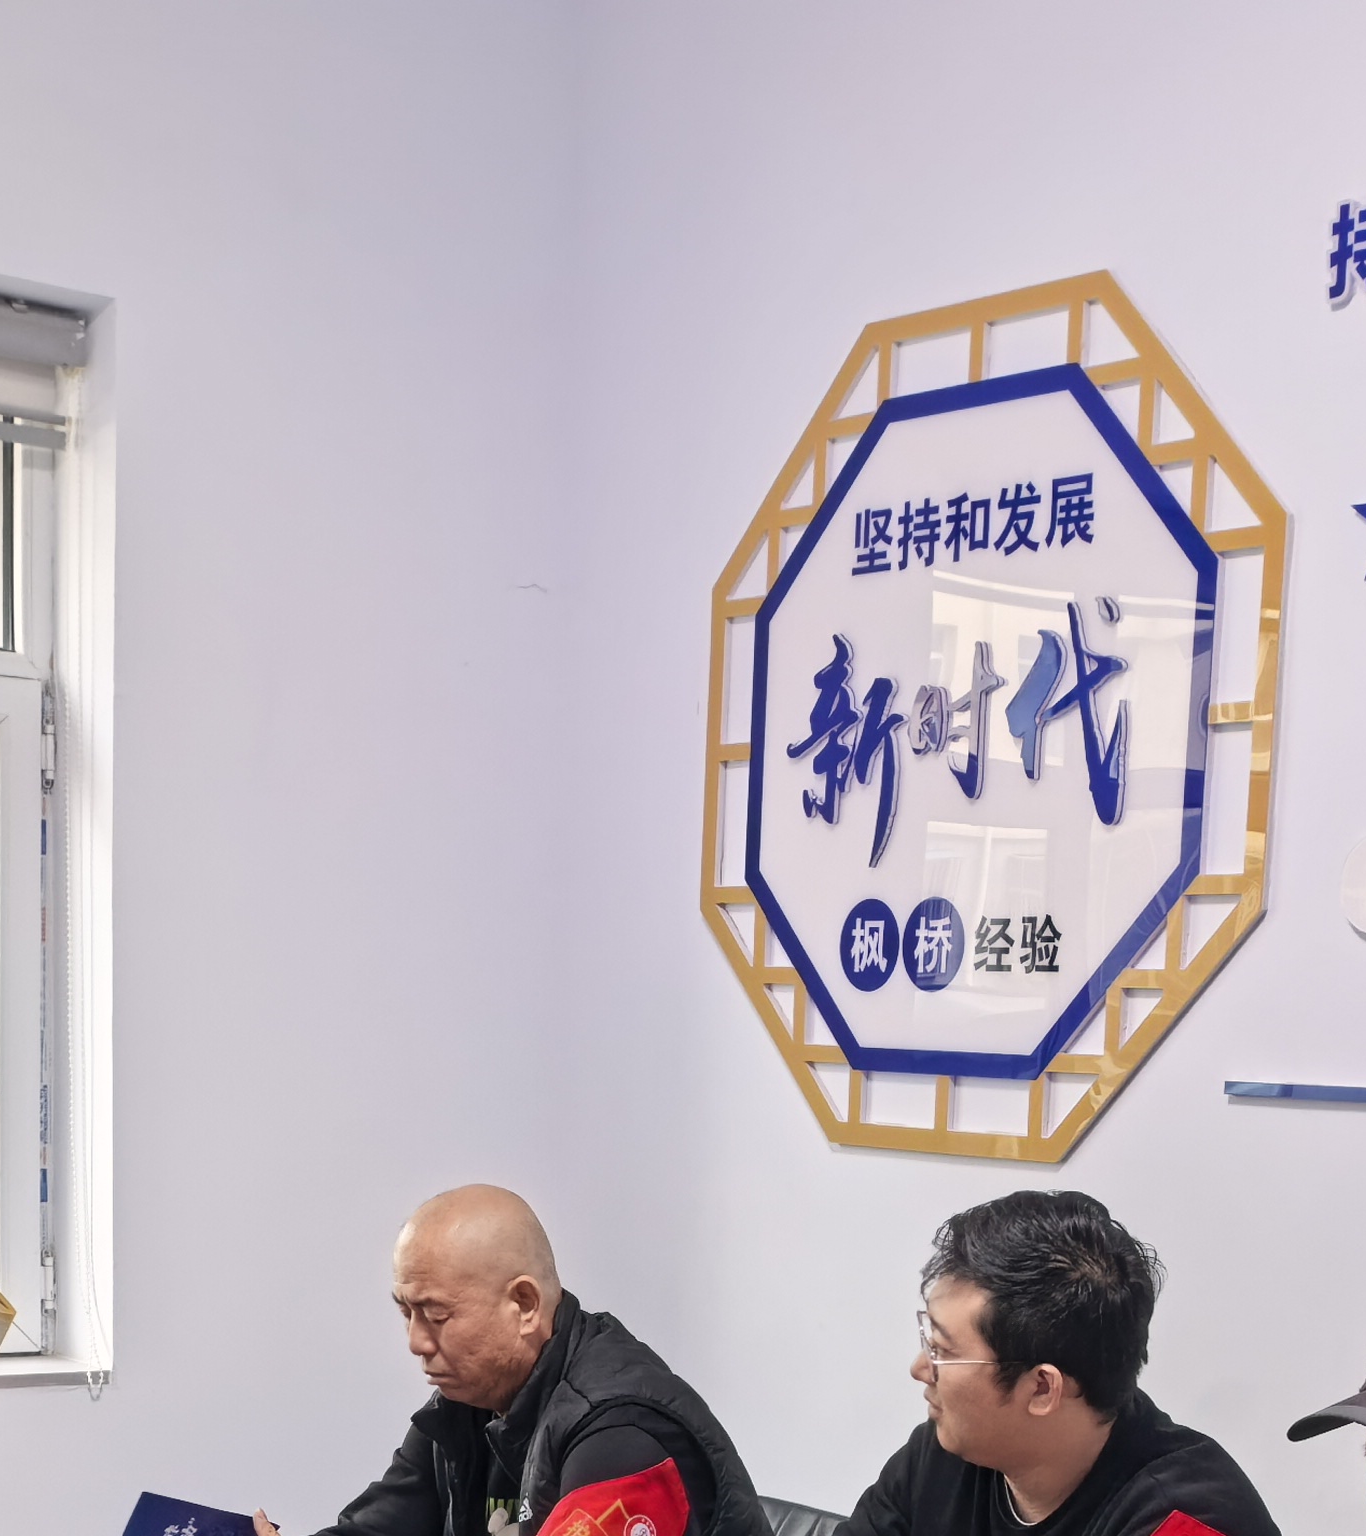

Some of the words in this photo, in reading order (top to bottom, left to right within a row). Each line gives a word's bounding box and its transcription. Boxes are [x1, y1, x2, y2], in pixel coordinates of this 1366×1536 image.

[851, 472, 1095, 576] 坚持和发展
[787, 594, 1125, 868] 新时代
[849, 912, 1063, 976] 枫桥经验
